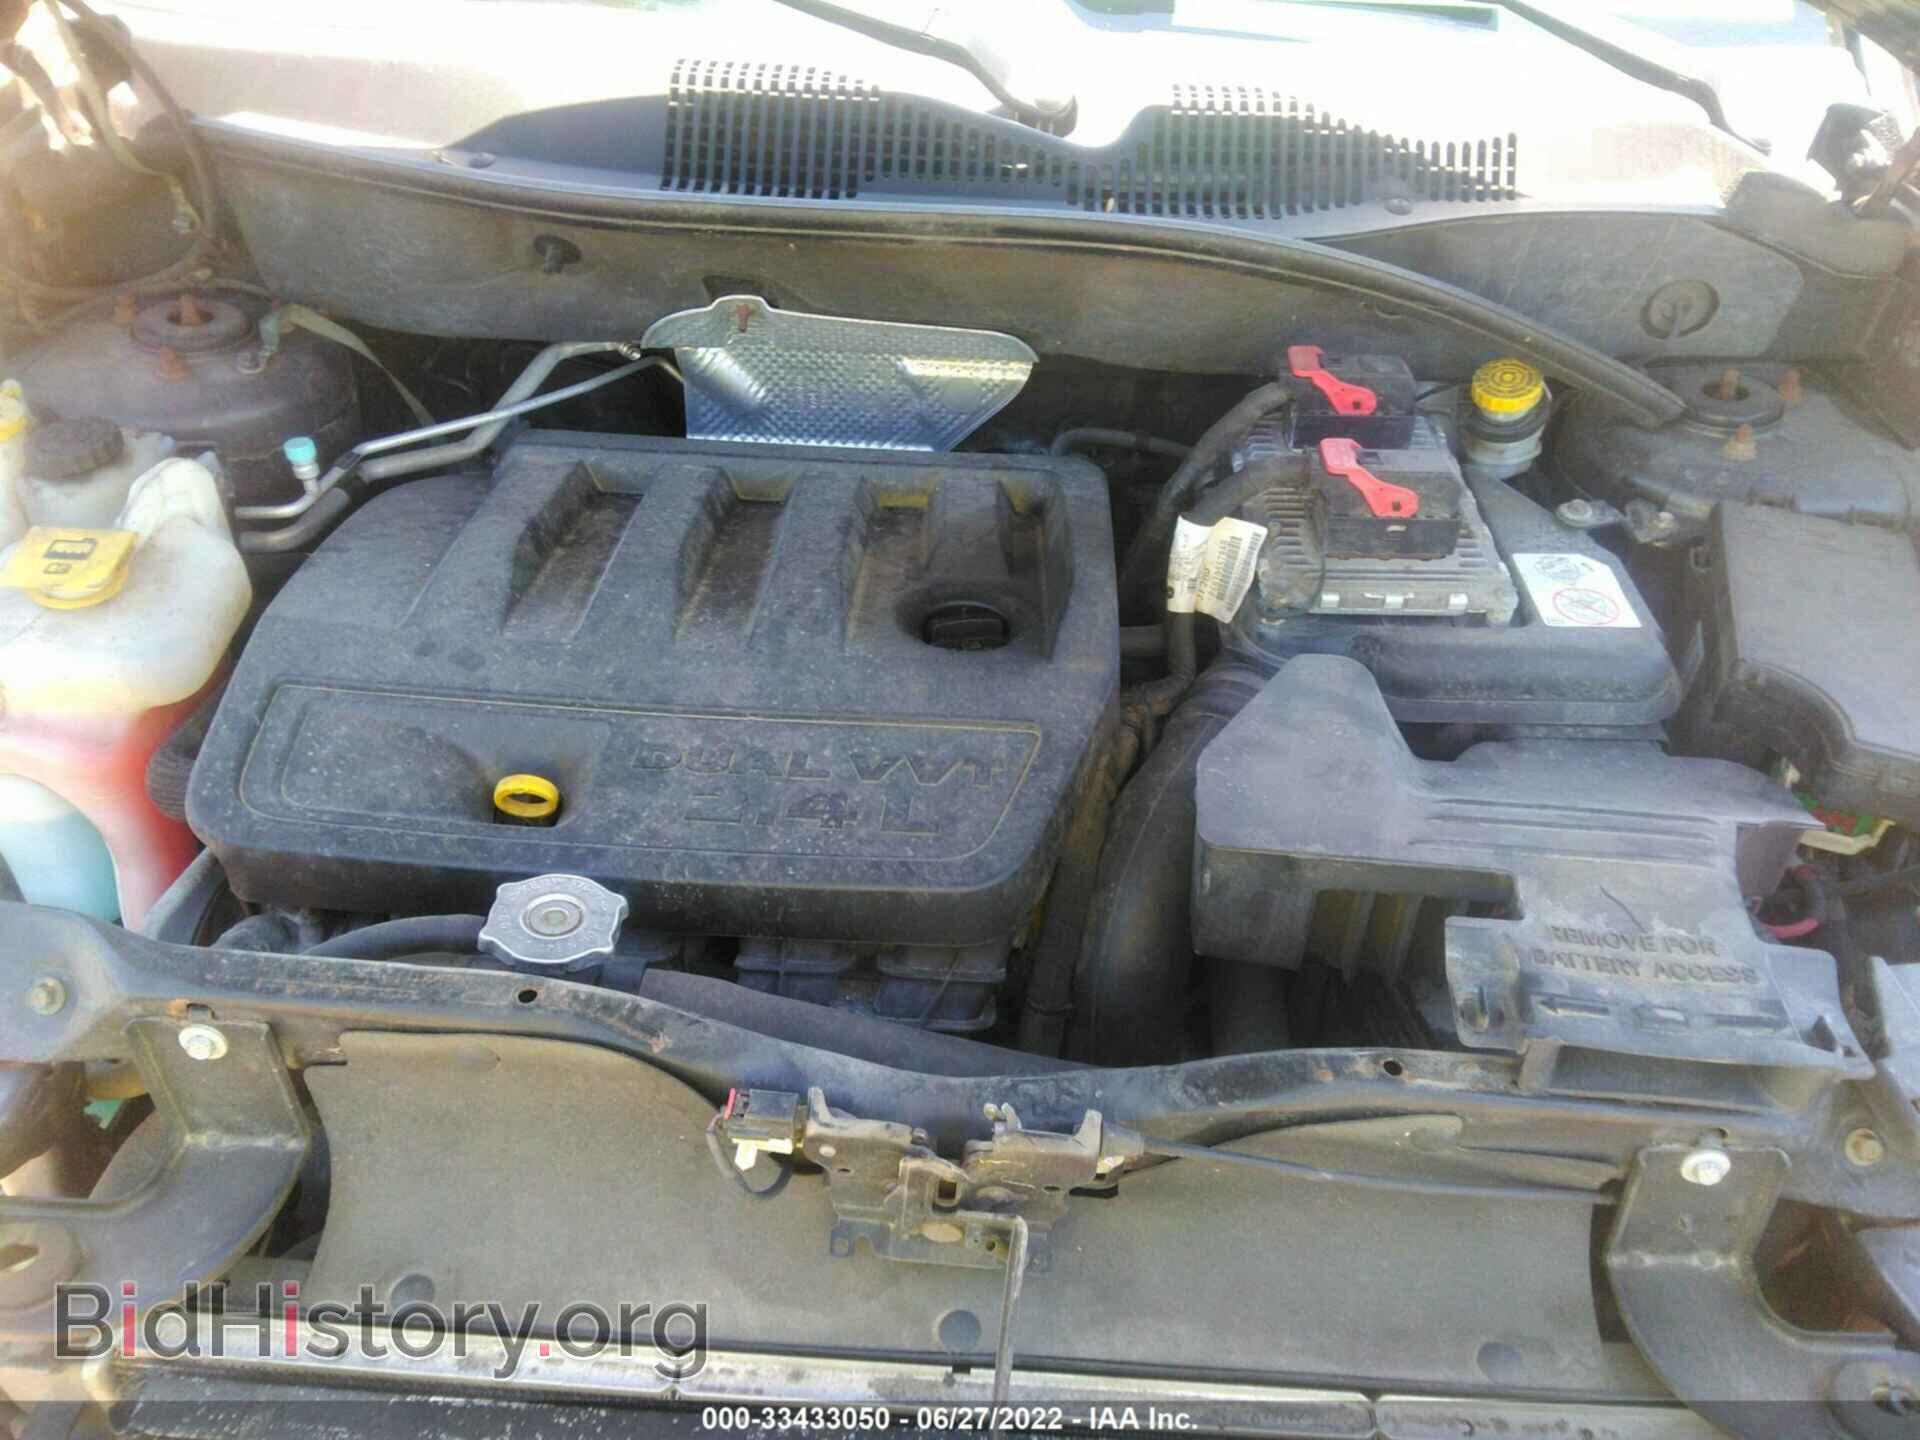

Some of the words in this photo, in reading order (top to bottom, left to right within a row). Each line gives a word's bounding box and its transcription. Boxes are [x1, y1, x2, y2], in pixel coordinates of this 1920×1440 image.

[631, 741, 831, 782] DUAL
[1549, 925, 1657, 953] REMOVE
[1662, 935, 1720, 958] FOR
[1531, 947, 1642, 977] BATTERY
[1653, 961, 1760, 985] ACCESS
